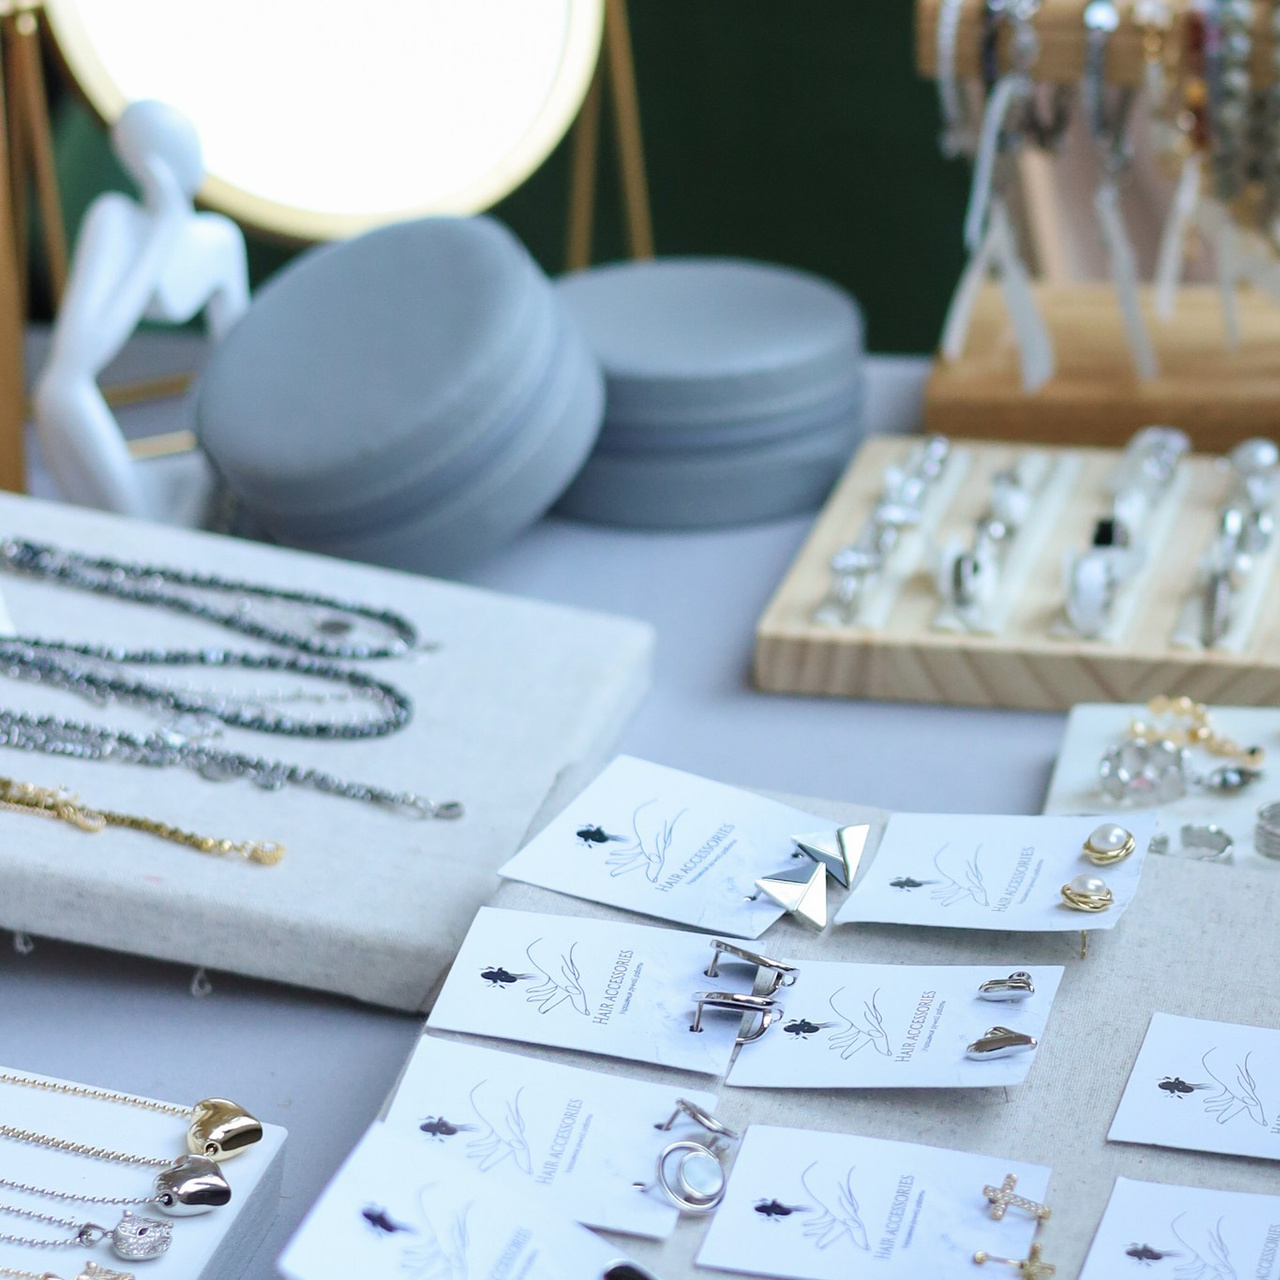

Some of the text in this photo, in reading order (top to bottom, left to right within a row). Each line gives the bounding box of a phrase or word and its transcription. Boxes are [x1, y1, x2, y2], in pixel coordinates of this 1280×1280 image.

[655, 823, 735, 892] HAIR ACCESSORIES
[991, 897, 1012, 912] HAIR
[592, 949, 634, 1025] HAIR ACCESSORIES
[894, 990, 936, 1062] HAIR ACCESSORIES
[534, 1160, 560, 1185] HAIR
[549, 1098, 583, 1160] ACCESSORIES
[873, 1236, 895, 1260] HAIR
[885, 1174, 915, 1236] ACCESSORIES
